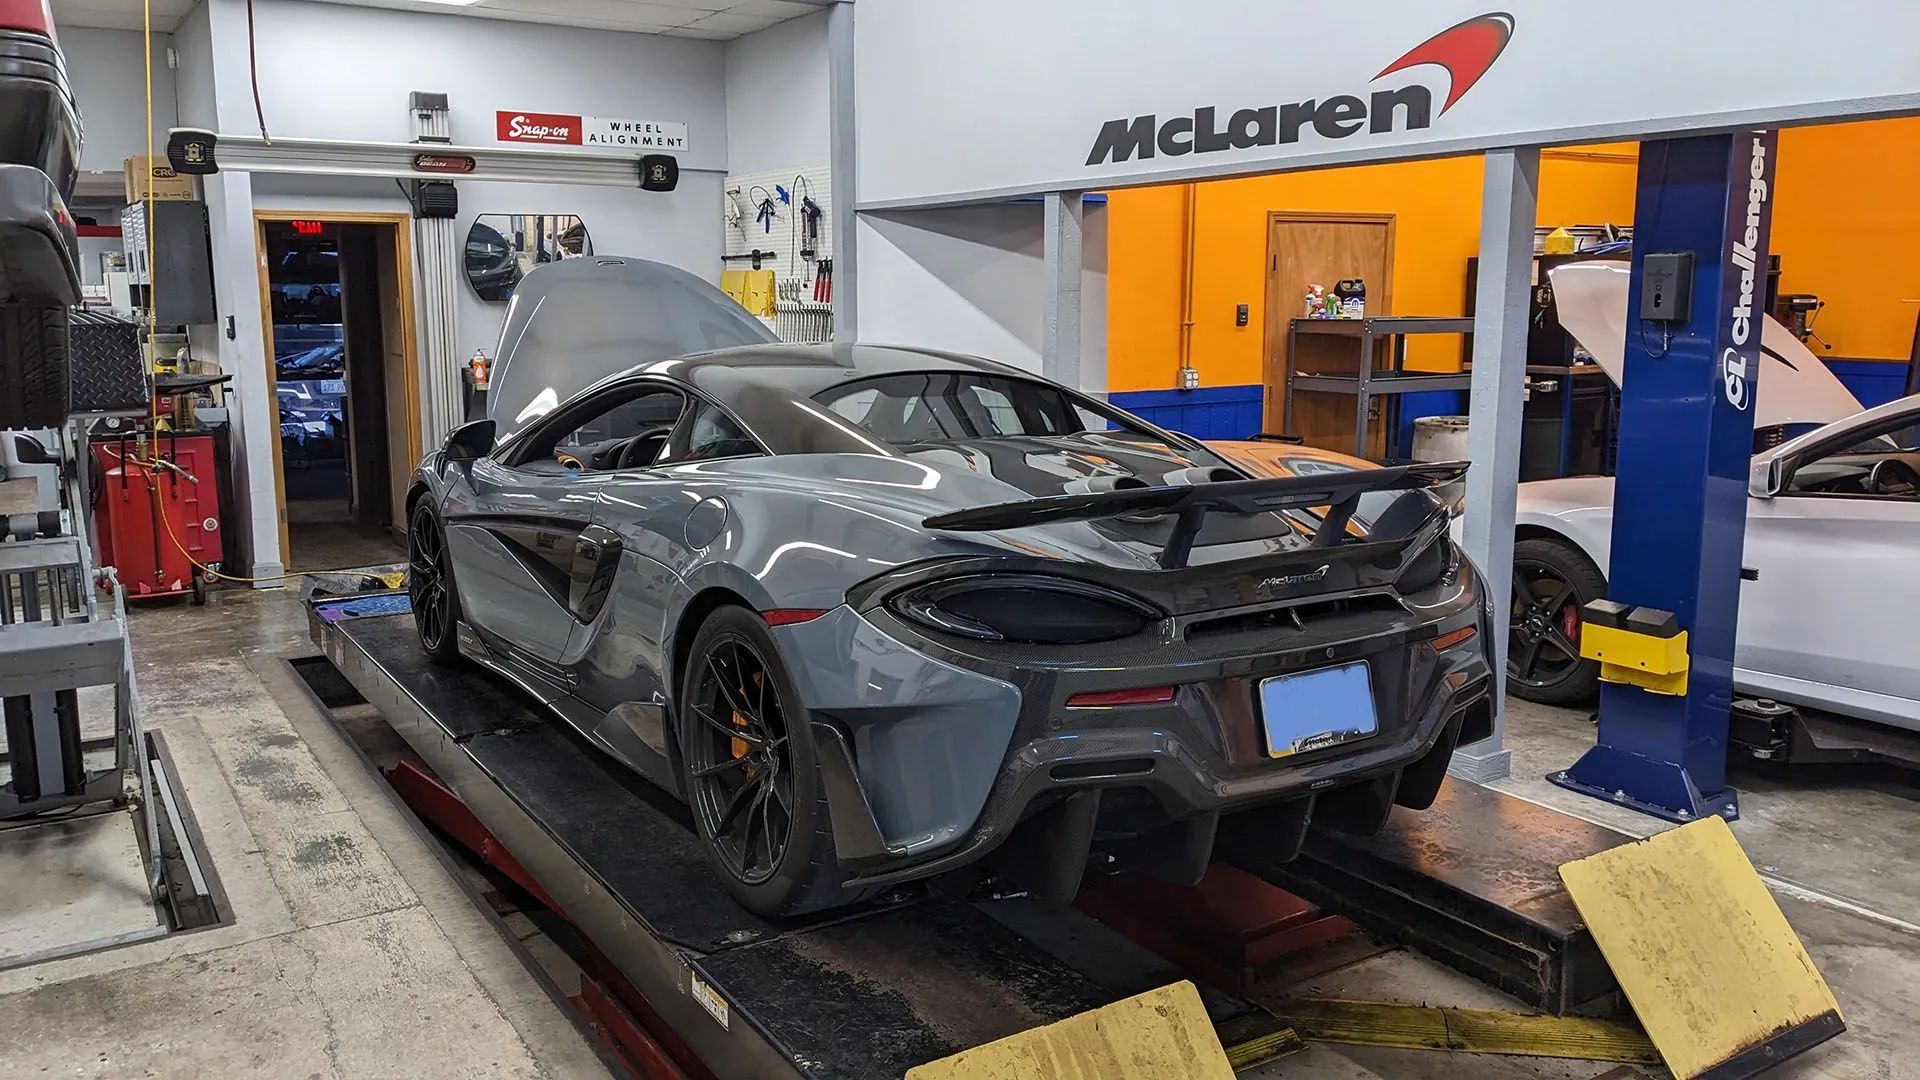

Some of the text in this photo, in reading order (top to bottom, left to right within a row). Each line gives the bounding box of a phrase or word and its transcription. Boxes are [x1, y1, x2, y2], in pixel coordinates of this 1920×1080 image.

[509, 115, 569, 139] Snap-on
[610, 122, 662, 133] WHEEL
[1085, 84, 1431, 166] McLaren
[589, 133, 683, 146] ALIGNMENT
[1731, 138, 1767, 345] Challenger
